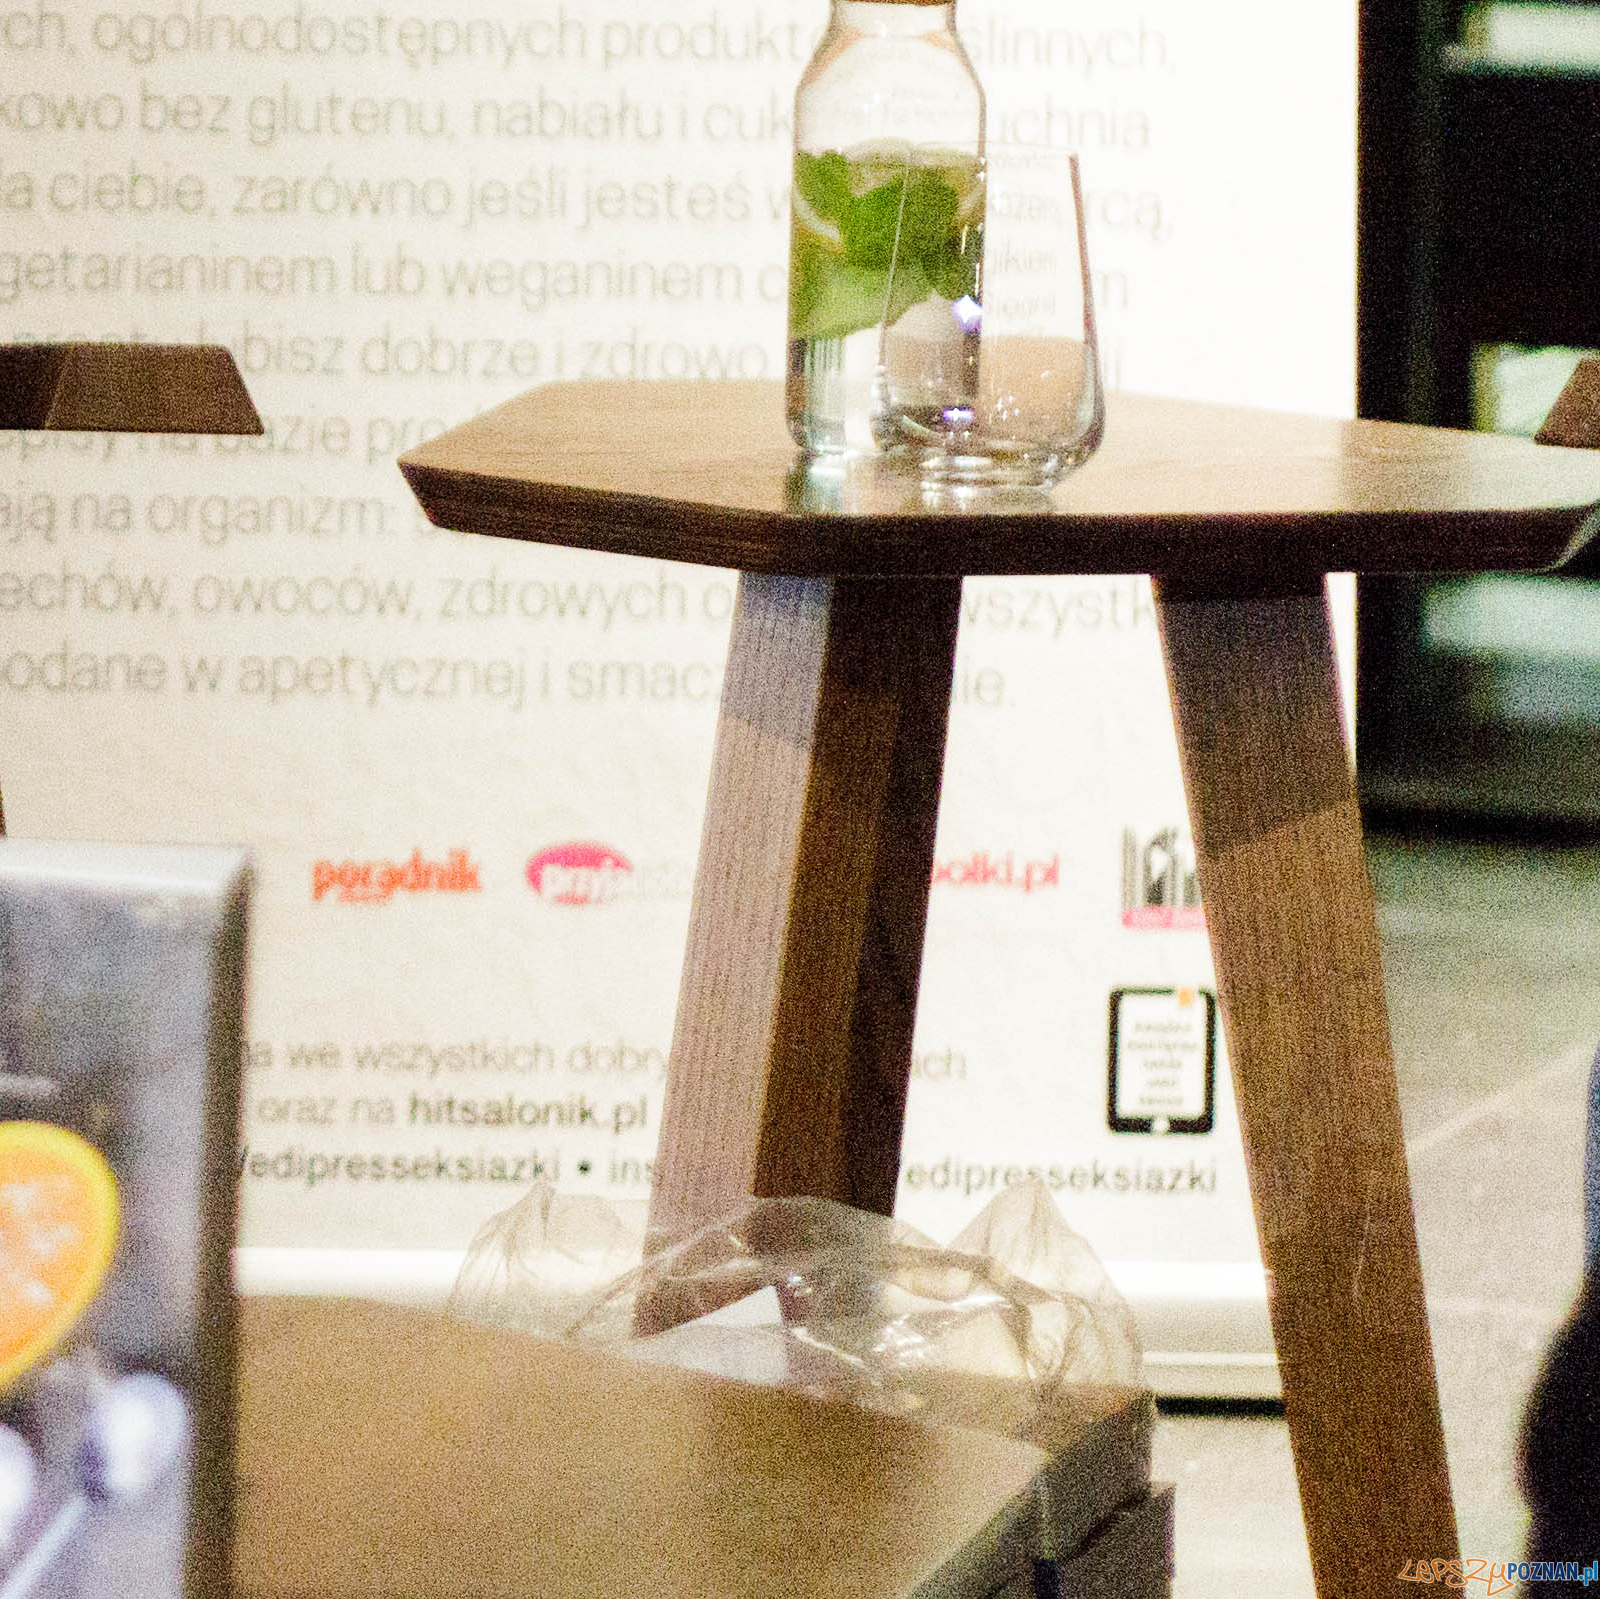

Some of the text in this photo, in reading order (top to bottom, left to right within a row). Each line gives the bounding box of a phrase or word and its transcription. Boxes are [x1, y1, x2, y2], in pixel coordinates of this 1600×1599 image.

[138, 79, 230, 135] bez
[247, 81, 456, 149] glutenu,
[472, 85, 664, 144] nabiału
[677, 89, 689, 141] i
[704, 89, 794, 143] cuk
[998, 94, 1151, 149] uchnia
[48, 158, 217, 220] ciebie,
[232, 162, 453, 219] zarówno
[459, 167, 568, 231] jeśli
[576, 169, 751, 233] jesteś
[351, 243, 425, 297] lub
[441, 250, 743, 313] weganinem
[359, 322, 540, 378] dobrze
[554, 327, 565, 377] i
[580, 327, 769, 380] zdrowo
[69, 493, 133, 535] na
[192, 564, 424, 621] owoców,
[438, 562, 687, 632] zdrowych
[182, 657, 222, 695] w
[236, 647, 529, 712] apetycznej
[541, 647, 552, 698] i
[566, 656, 713, 701] smac
[310, 845, 483, 902] poradnik
[285, 1045, 341, 1069] we
[353, 1039, 557, 1078] wszystkich
[257, 1092, 648, 1134] oraz na hitsalonik.pl
[905, 1154, 1219, 1197] edipresseksiazki
